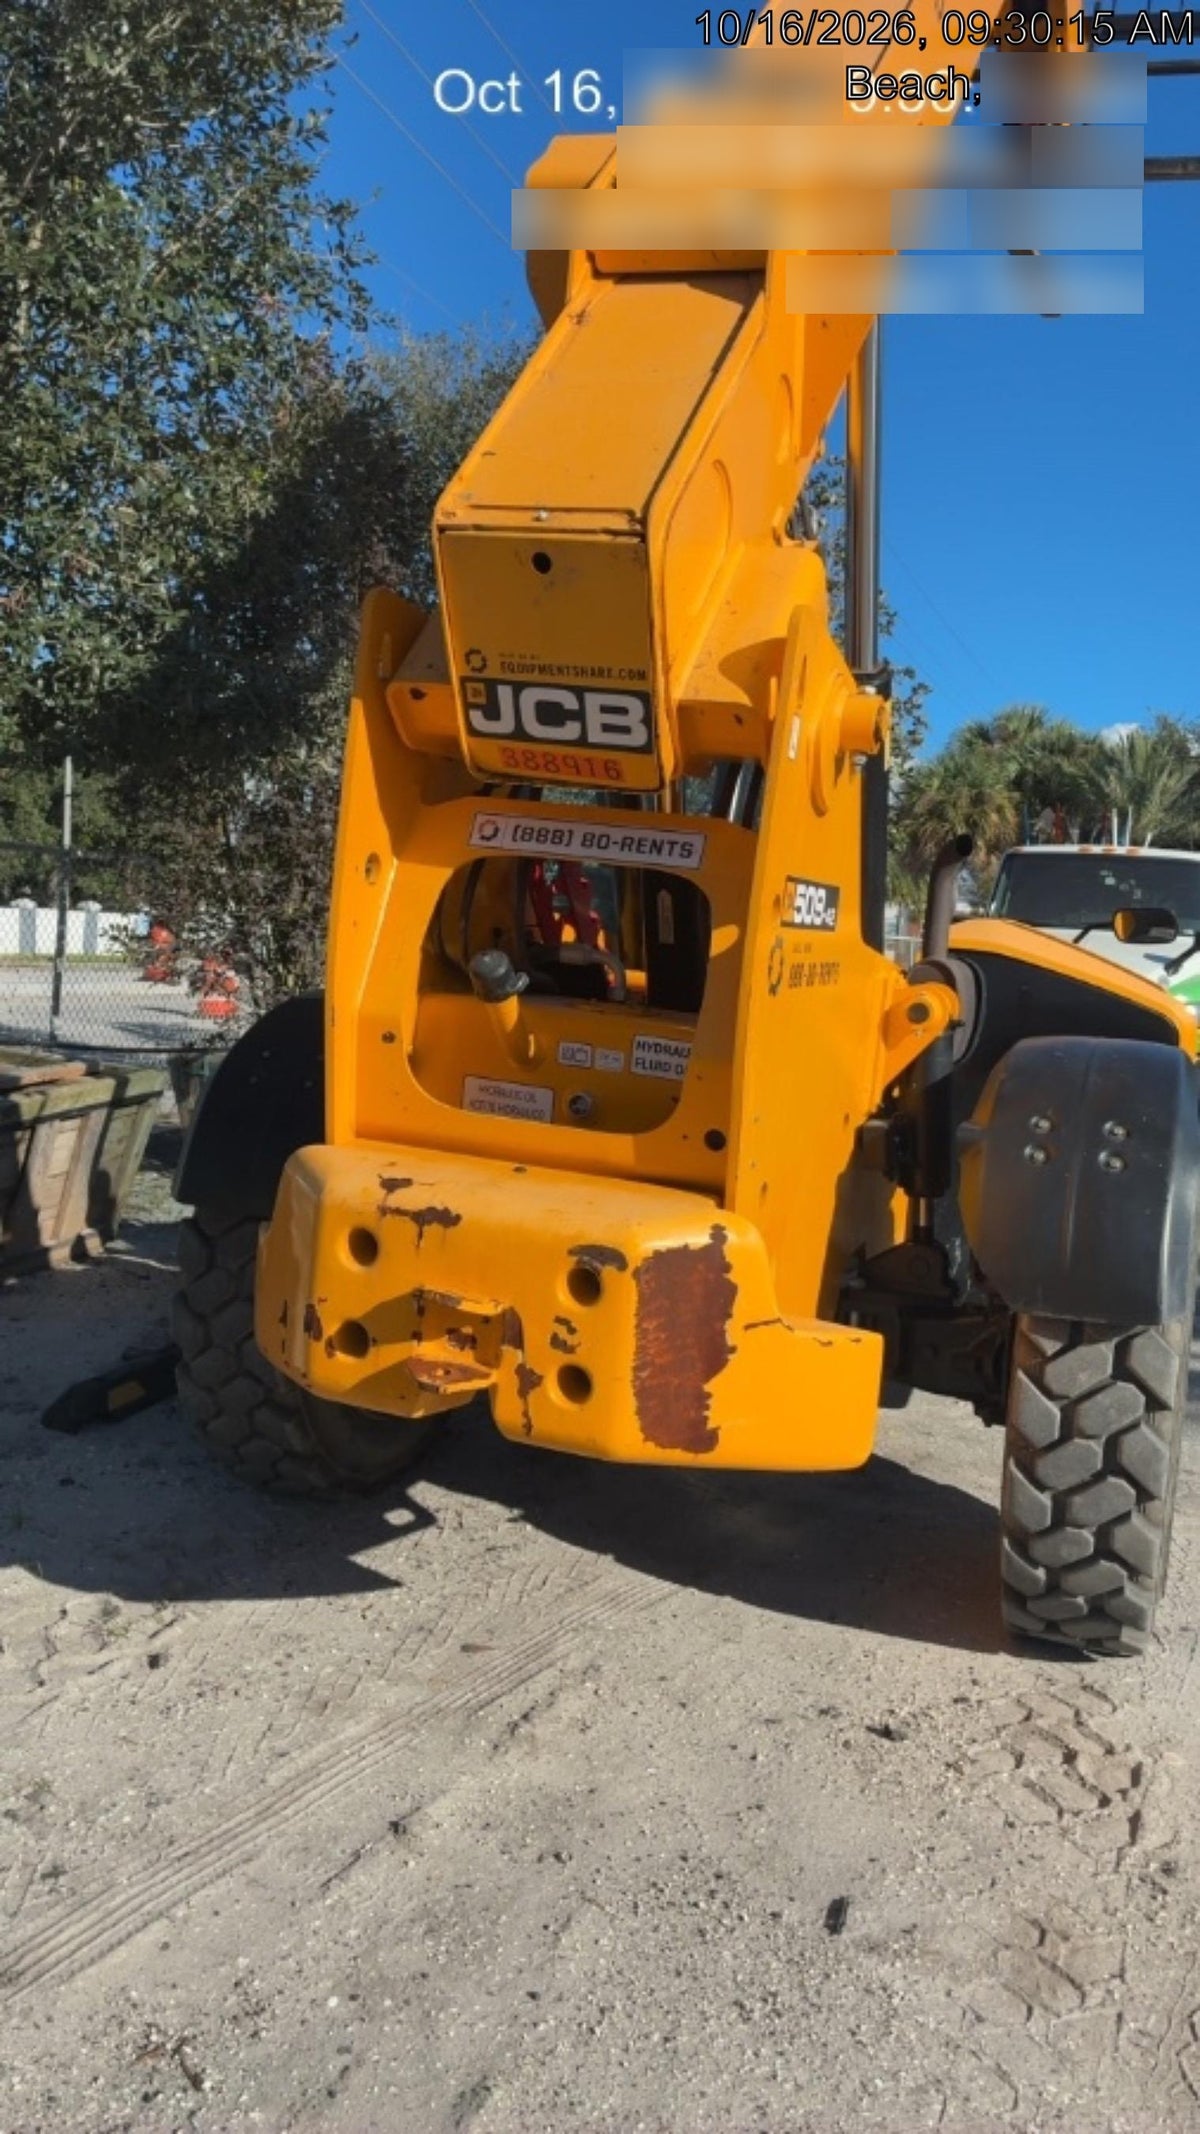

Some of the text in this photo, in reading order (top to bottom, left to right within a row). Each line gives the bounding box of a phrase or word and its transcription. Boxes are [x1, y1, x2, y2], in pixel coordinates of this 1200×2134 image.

[499, 660, 647, 681] EQUIPMENTSHARE.COM
[468, 684, 649, 748] JCB
[581, 832, 695, 859] 80-RENTS
